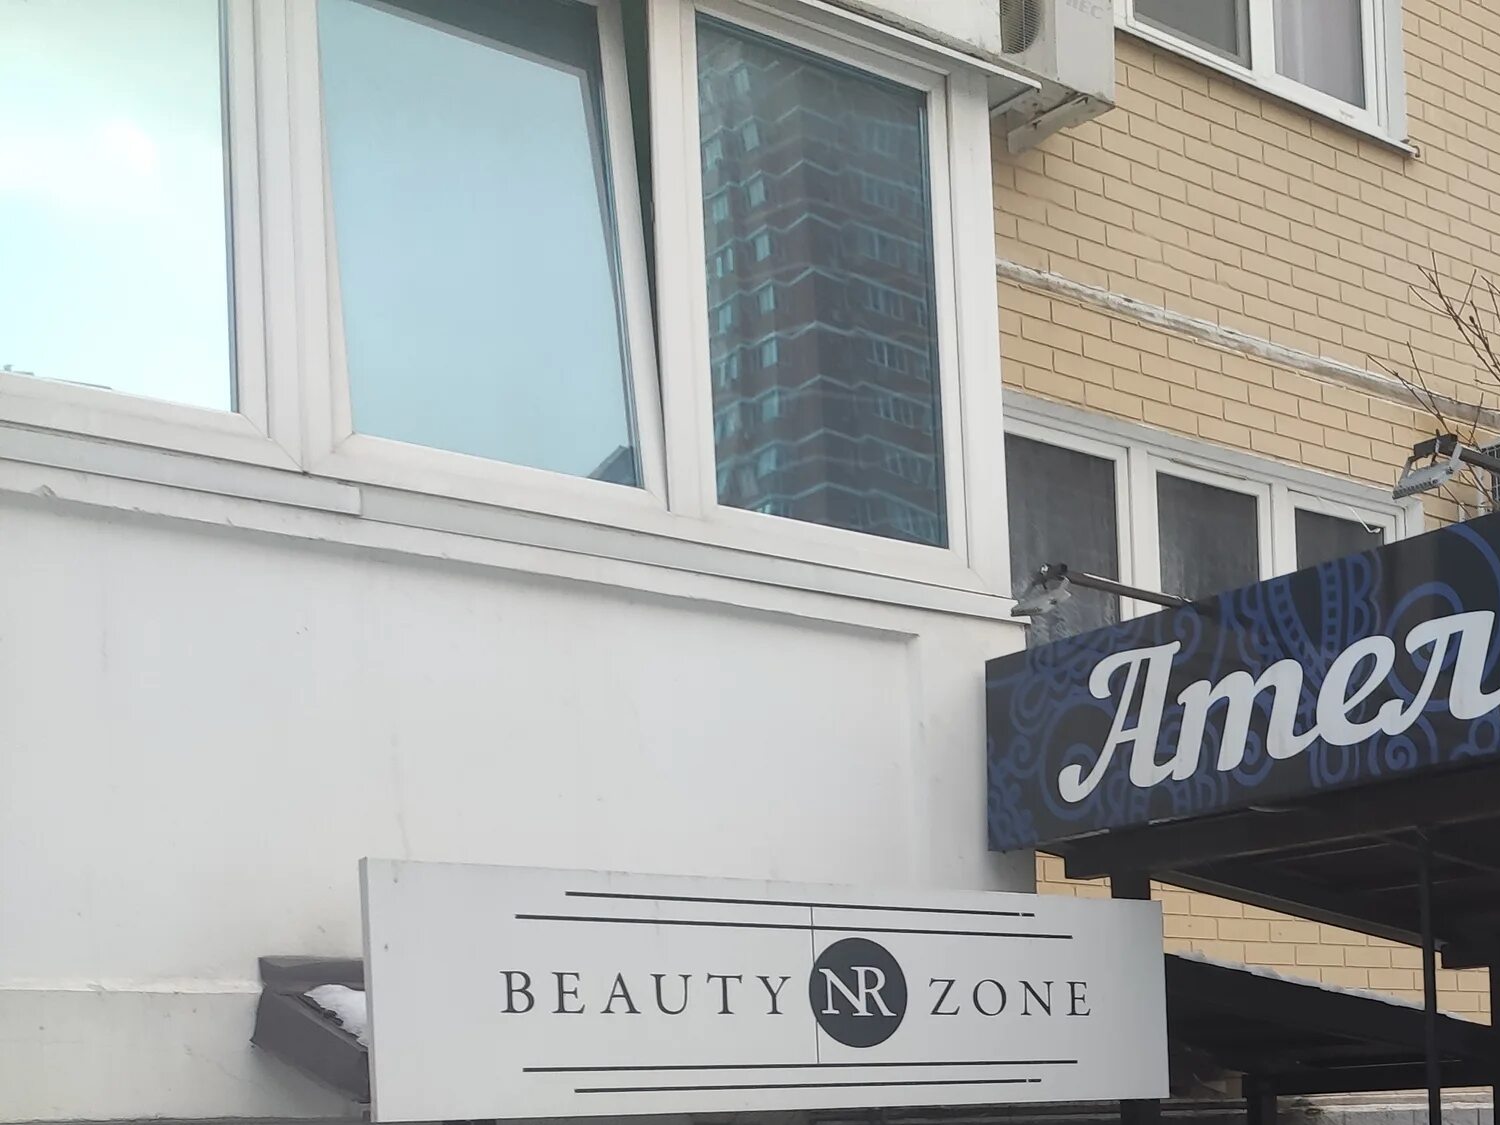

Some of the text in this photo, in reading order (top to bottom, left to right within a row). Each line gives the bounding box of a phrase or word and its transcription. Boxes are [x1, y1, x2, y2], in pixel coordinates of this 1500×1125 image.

[499, 965, 1092, 1018] BEAUTY NR ZONE
